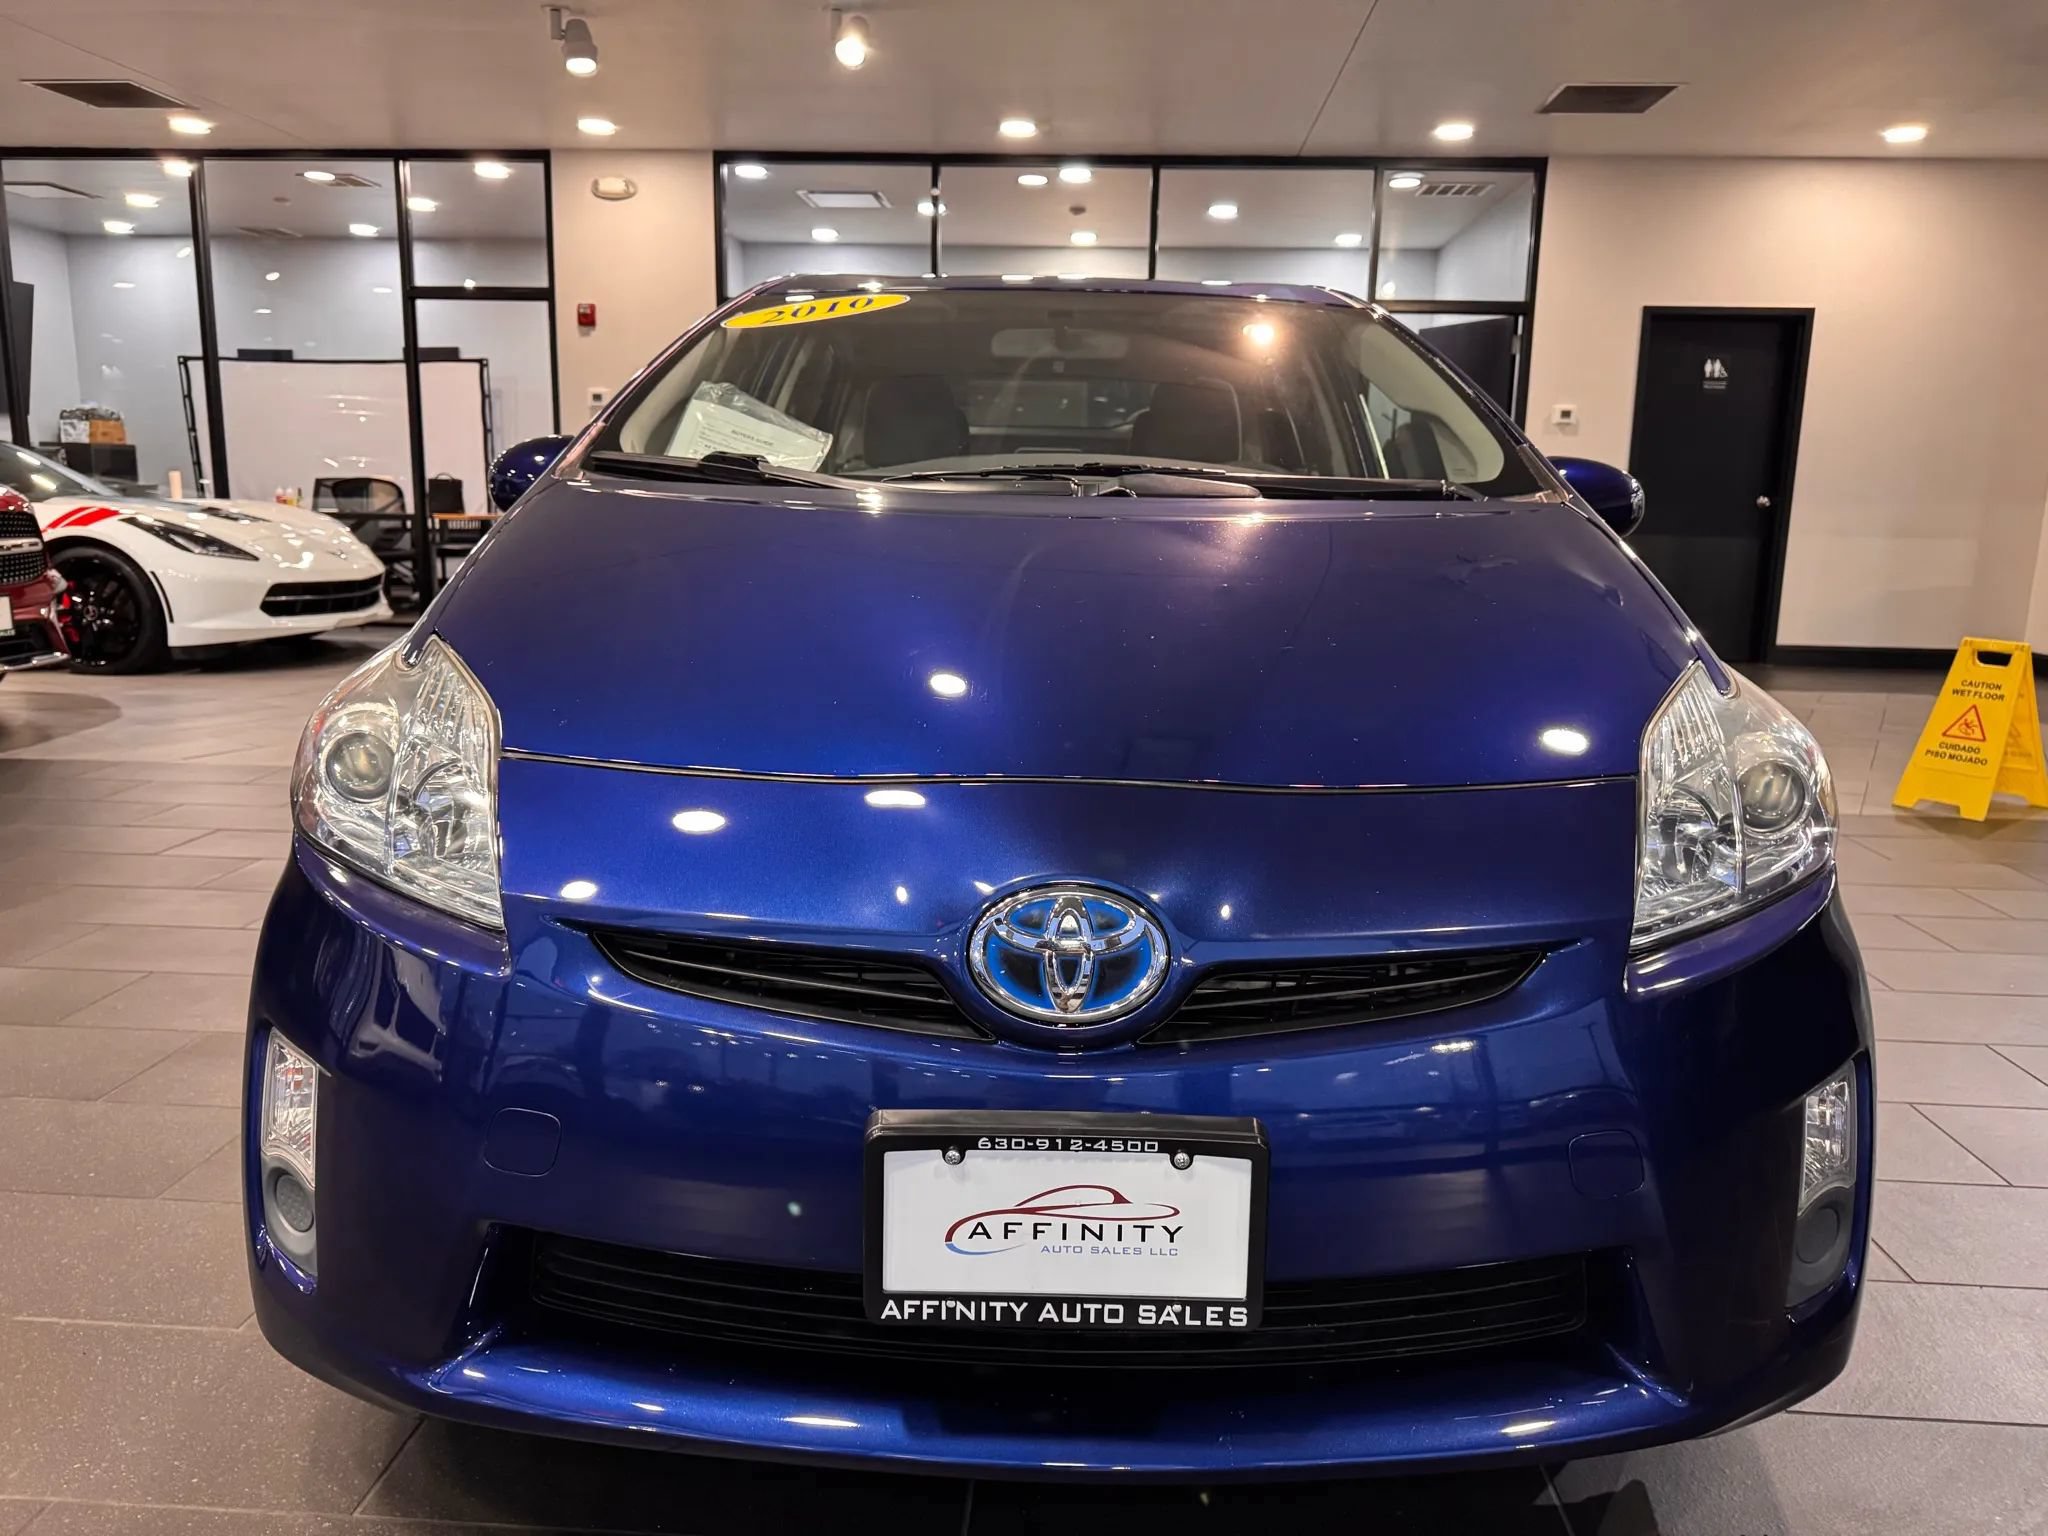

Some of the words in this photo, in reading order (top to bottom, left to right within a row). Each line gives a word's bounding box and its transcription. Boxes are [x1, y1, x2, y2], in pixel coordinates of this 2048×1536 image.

[760, 298, 874, 324] 2010
[1961, 679, 2002, 691] CAUTION
[1952, 688, 1972, 697] WET
[1973, 690, 2005, 702] FLOOR
[1938, 741, 1981, 755] CUIDADO
[1925, 749, 1947, 760] PISO
[1948, 753, 1988, 766] MOJADO
[977, 1137, 1160, 1153] 630-912-4500
[967, 1221, 1184, 1244] AFFINITY
[1040, 1245, 1083, 1255] AUTO
[1090, 1245, 1142, 1256] SALES
[1149, 1247, 1179, 1257] LLC
[880, 1299, 1029, 1323] AFFINITY
[1037, 1301, 1125, 1325] AUTO
[1137, 1304, 1249, 1327] SALES
